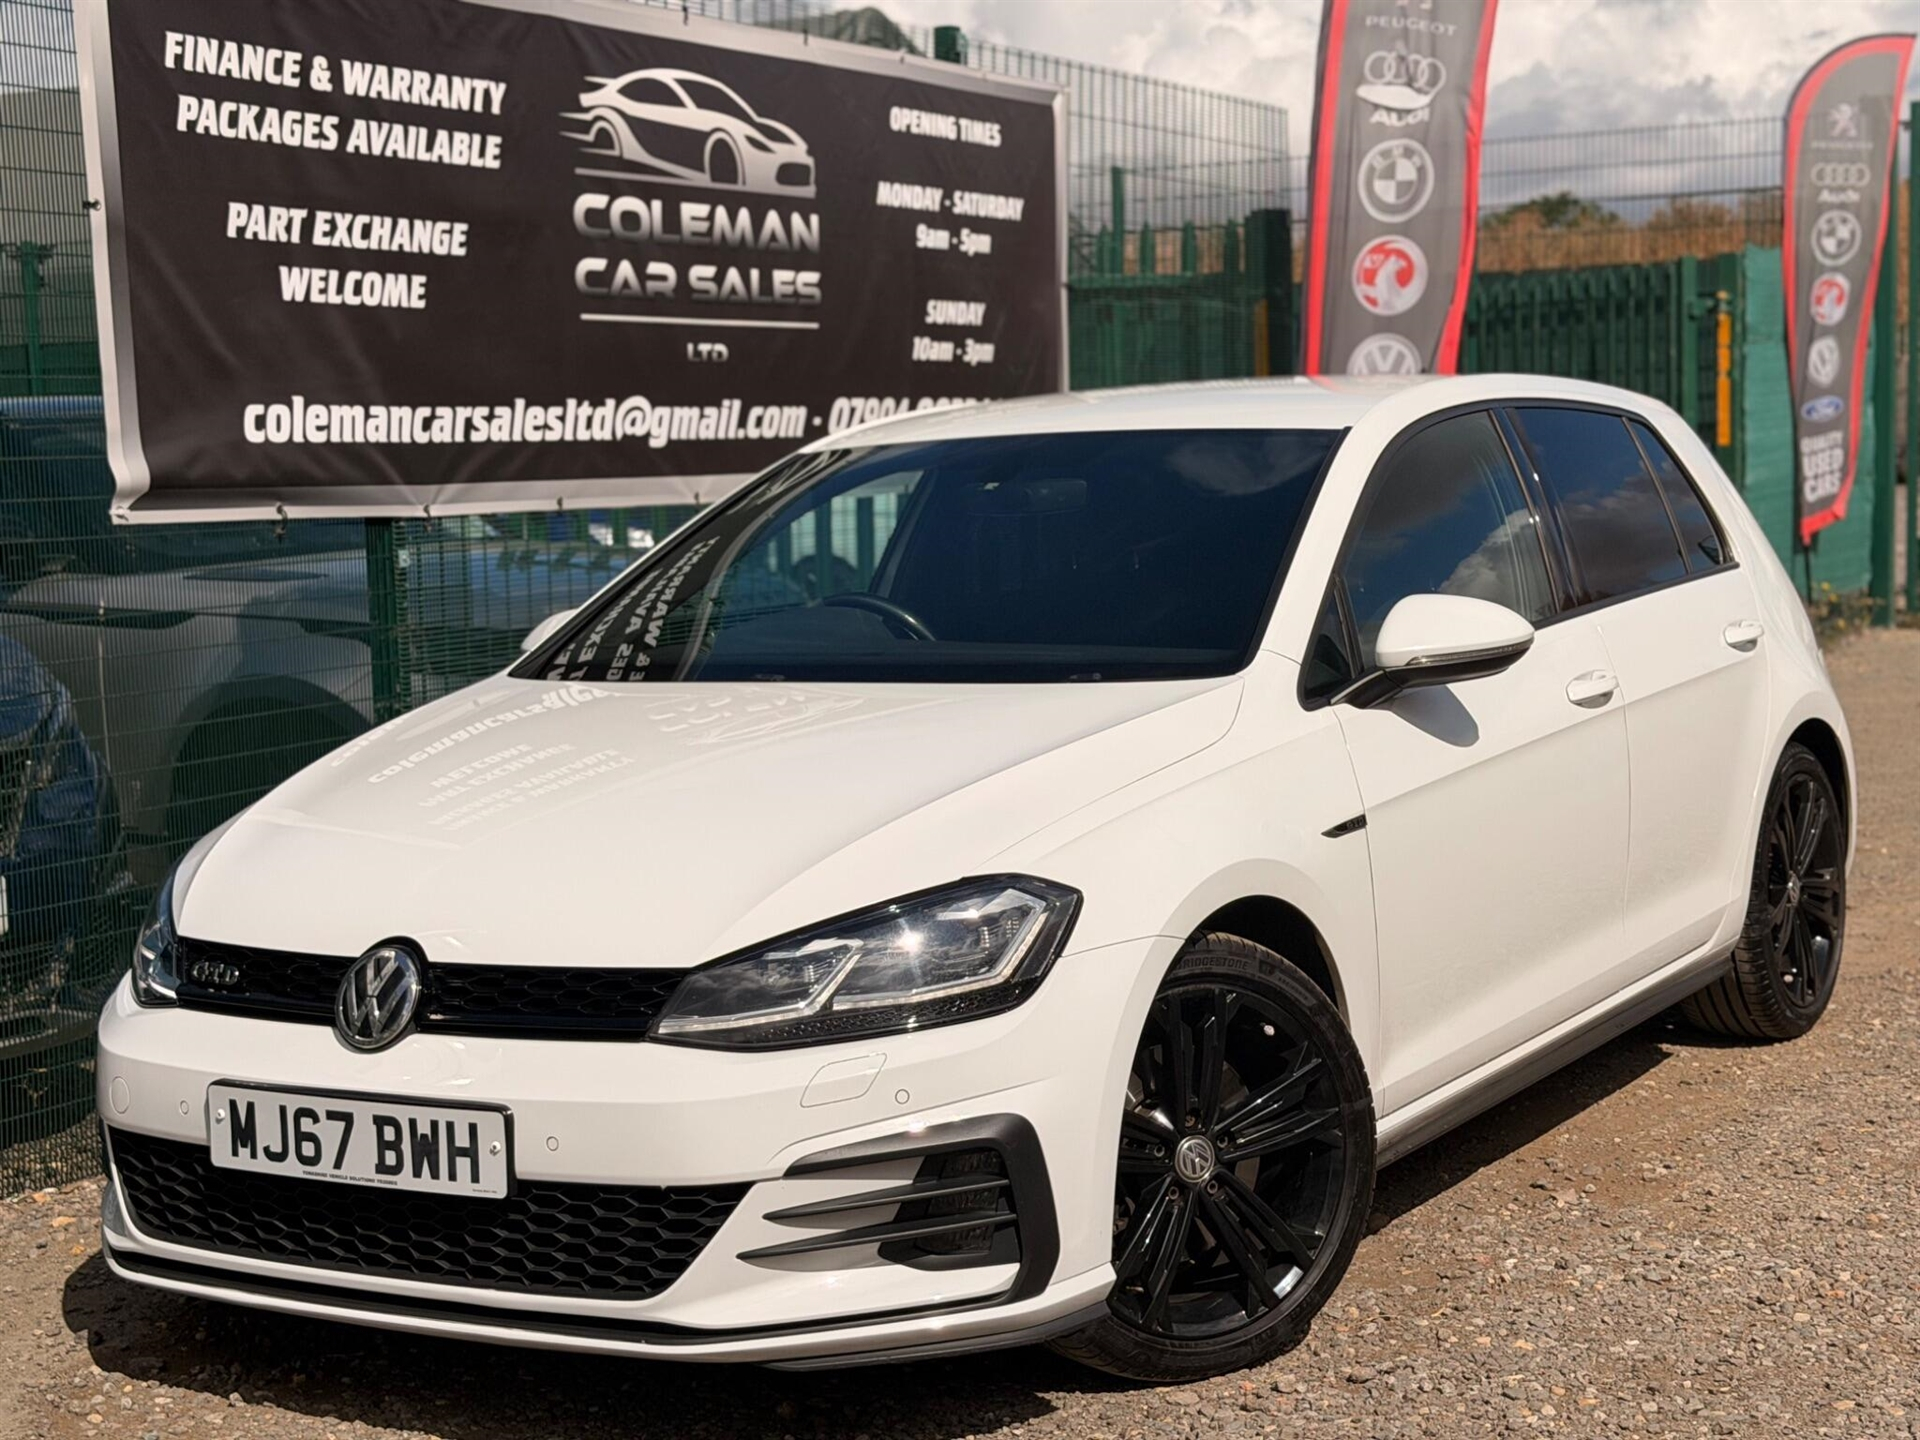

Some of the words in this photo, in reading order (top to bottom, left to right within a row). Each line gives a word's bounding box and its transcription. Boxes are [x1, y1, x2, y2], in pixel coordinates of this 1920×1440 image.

[1365, 15, 1457, 37] PEUGEOT
[164, 30, 303, 88] FINANCE
[309, 55, 333, 92] &
[340, 59, 507, 115] WARRANTY
[176, 94, 340, 151] PACKAGES
[345, 118, 503, 170] AVAILABLE
[889, 105, 959, 141] OPENING
[958, 117, 1002, 148] TIMES
[572, 192, 821, 252] COLEMAN
[875, 180, 944, 213] MONDAY
[951, 189, 1025, 221] SATURDAY
[226, 201, 308, 244] PART
[312, 210, 469, 257] EXCHANGE
[915, 223, 951, 250] 9am
[958, 227, 992, 257] 5pm
[278, 265, 427, 309] WELCOME
[574, 256, 678, 299] CAR
[687, 263, 822, 304] SALES
[925, 299, 986, 326] SUNDAY
[686, 342, 729, 361] LTD
[912, 336, 955, 362] 10am
[962, 338, 995, 366] 3pm
[243, 395, 808, 448] colemancarsalesltd@gmail.com
[1803, 447, 1845, 478] USED
[1804, 472, 1842, 503] CARS
[228, 1098, 355, 1170] MJ67
[372, 1114, 480, 1184] BWH
